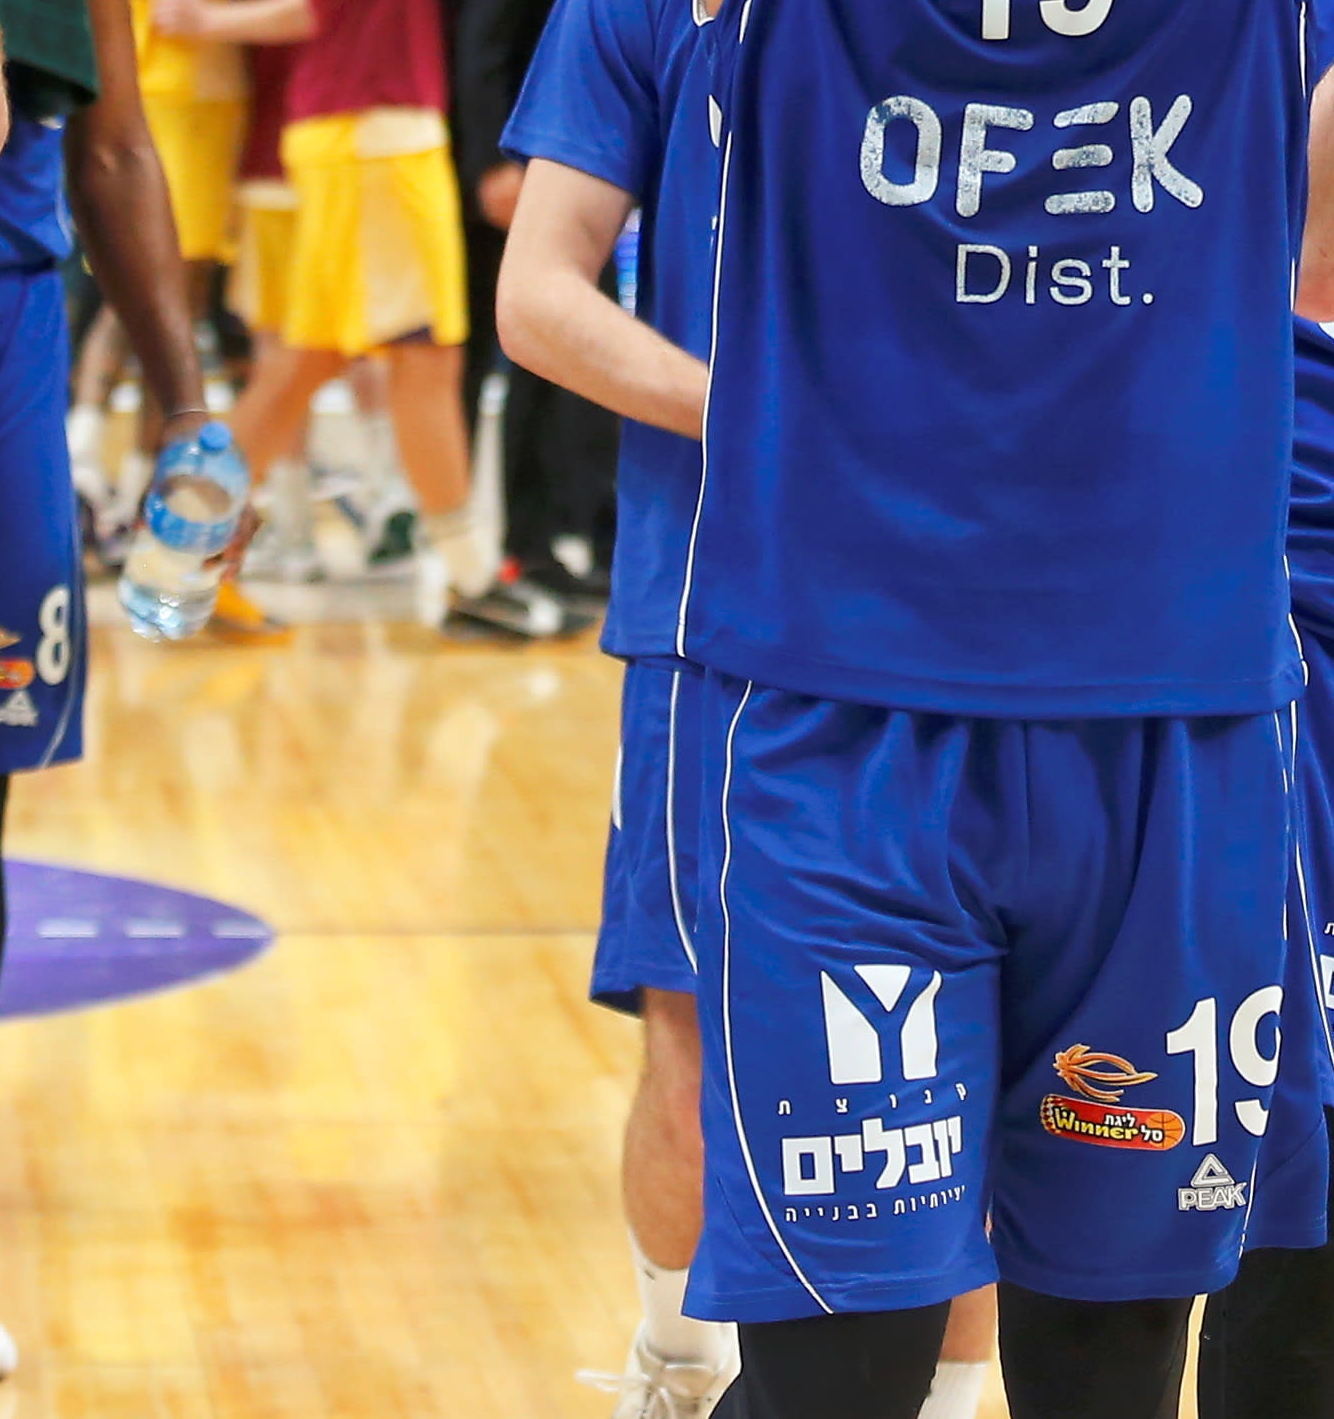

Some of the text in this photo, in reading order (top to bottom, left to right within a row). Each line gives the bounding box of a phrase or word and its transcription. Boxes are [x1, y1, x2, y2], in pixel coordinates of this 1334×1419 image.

[860, 94, 1204, 218] OFEK
[955, 242, 1156, 307] Dist.
[35, 584, 71, 686] 8
[1167, 985, 1284, 1146] 19
[1053, 1107, 1139, 1141] Winner
[1104, 1112, 1136, 1128] ליגת
[1142, 1124, 1163, 1142] סל
[782, 1116, 962, 1195] יובלים
[1178, 1182, 1247, 1211] PEAK
